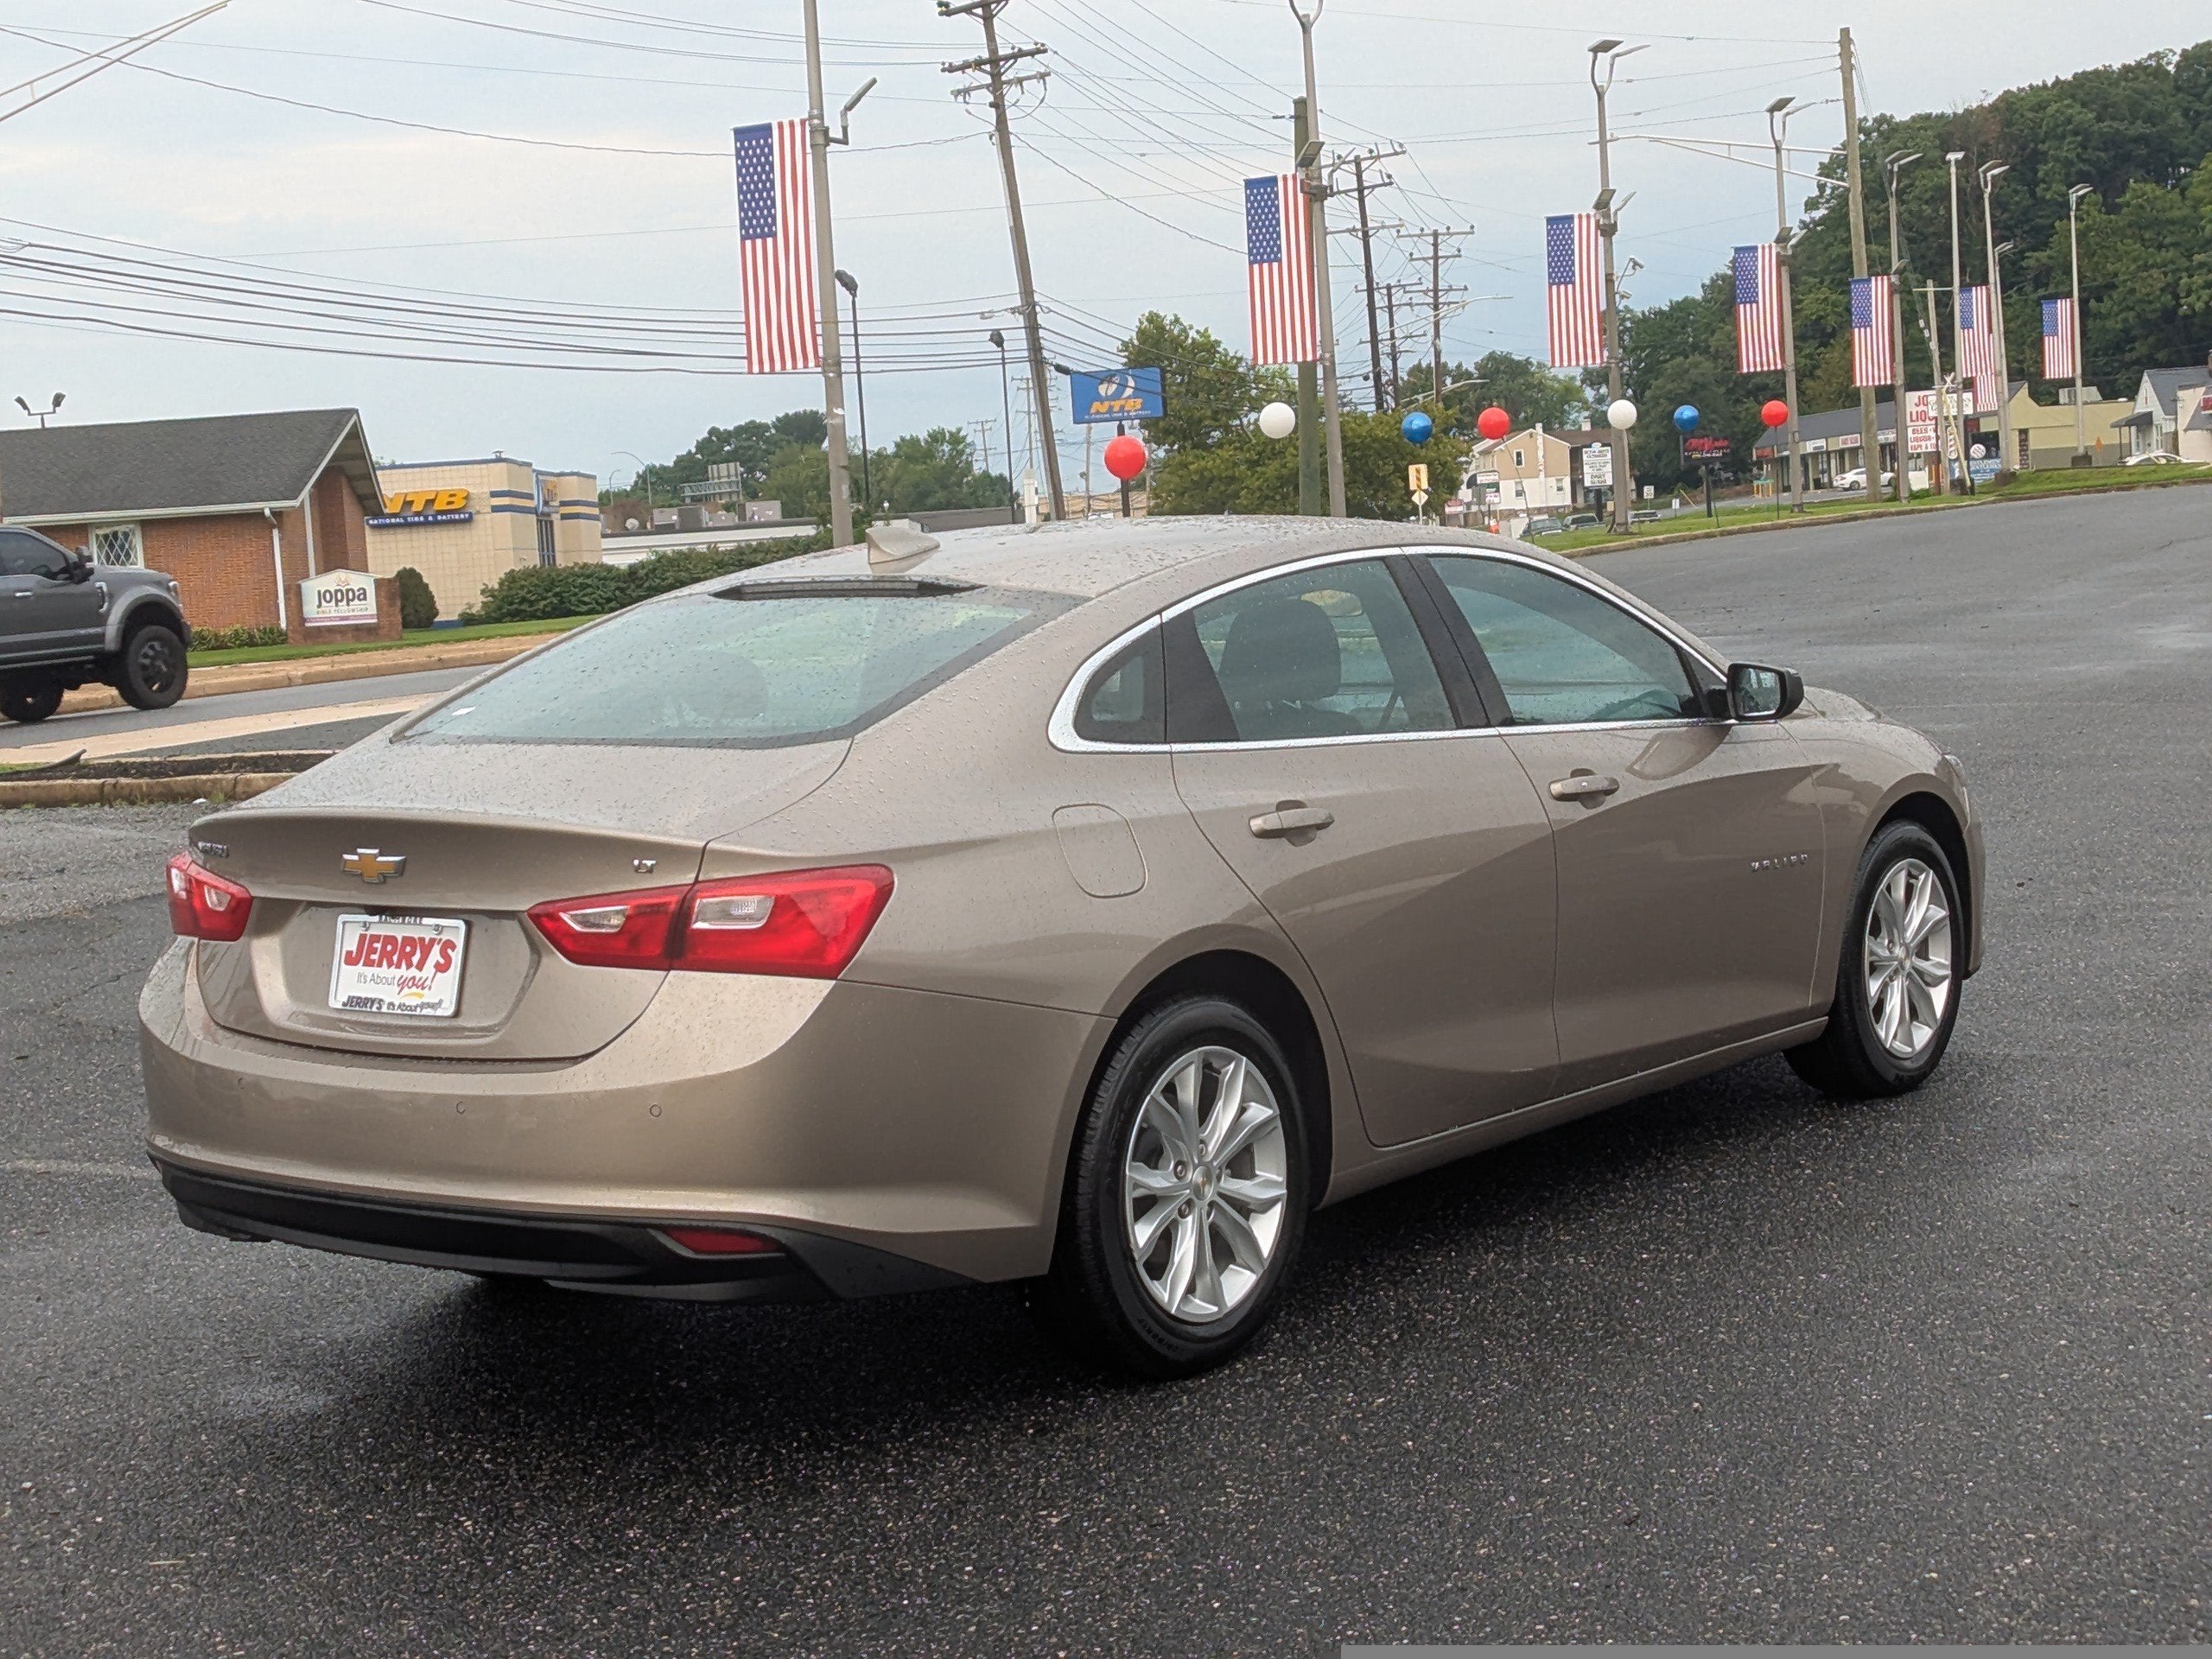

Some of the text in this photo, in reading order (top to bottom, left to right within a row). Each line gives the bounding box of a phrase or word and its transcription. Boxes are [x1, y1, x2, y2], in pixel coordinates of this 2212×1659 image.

[1089, 397, 1143, 415] NTB
[1914, 394, 1929, 408] JO
[344, 933, 458, 974] JERRY'S
[357, 969, 439, 995] It's About you!
[341, 995, 385, 1011] JERRY'S
